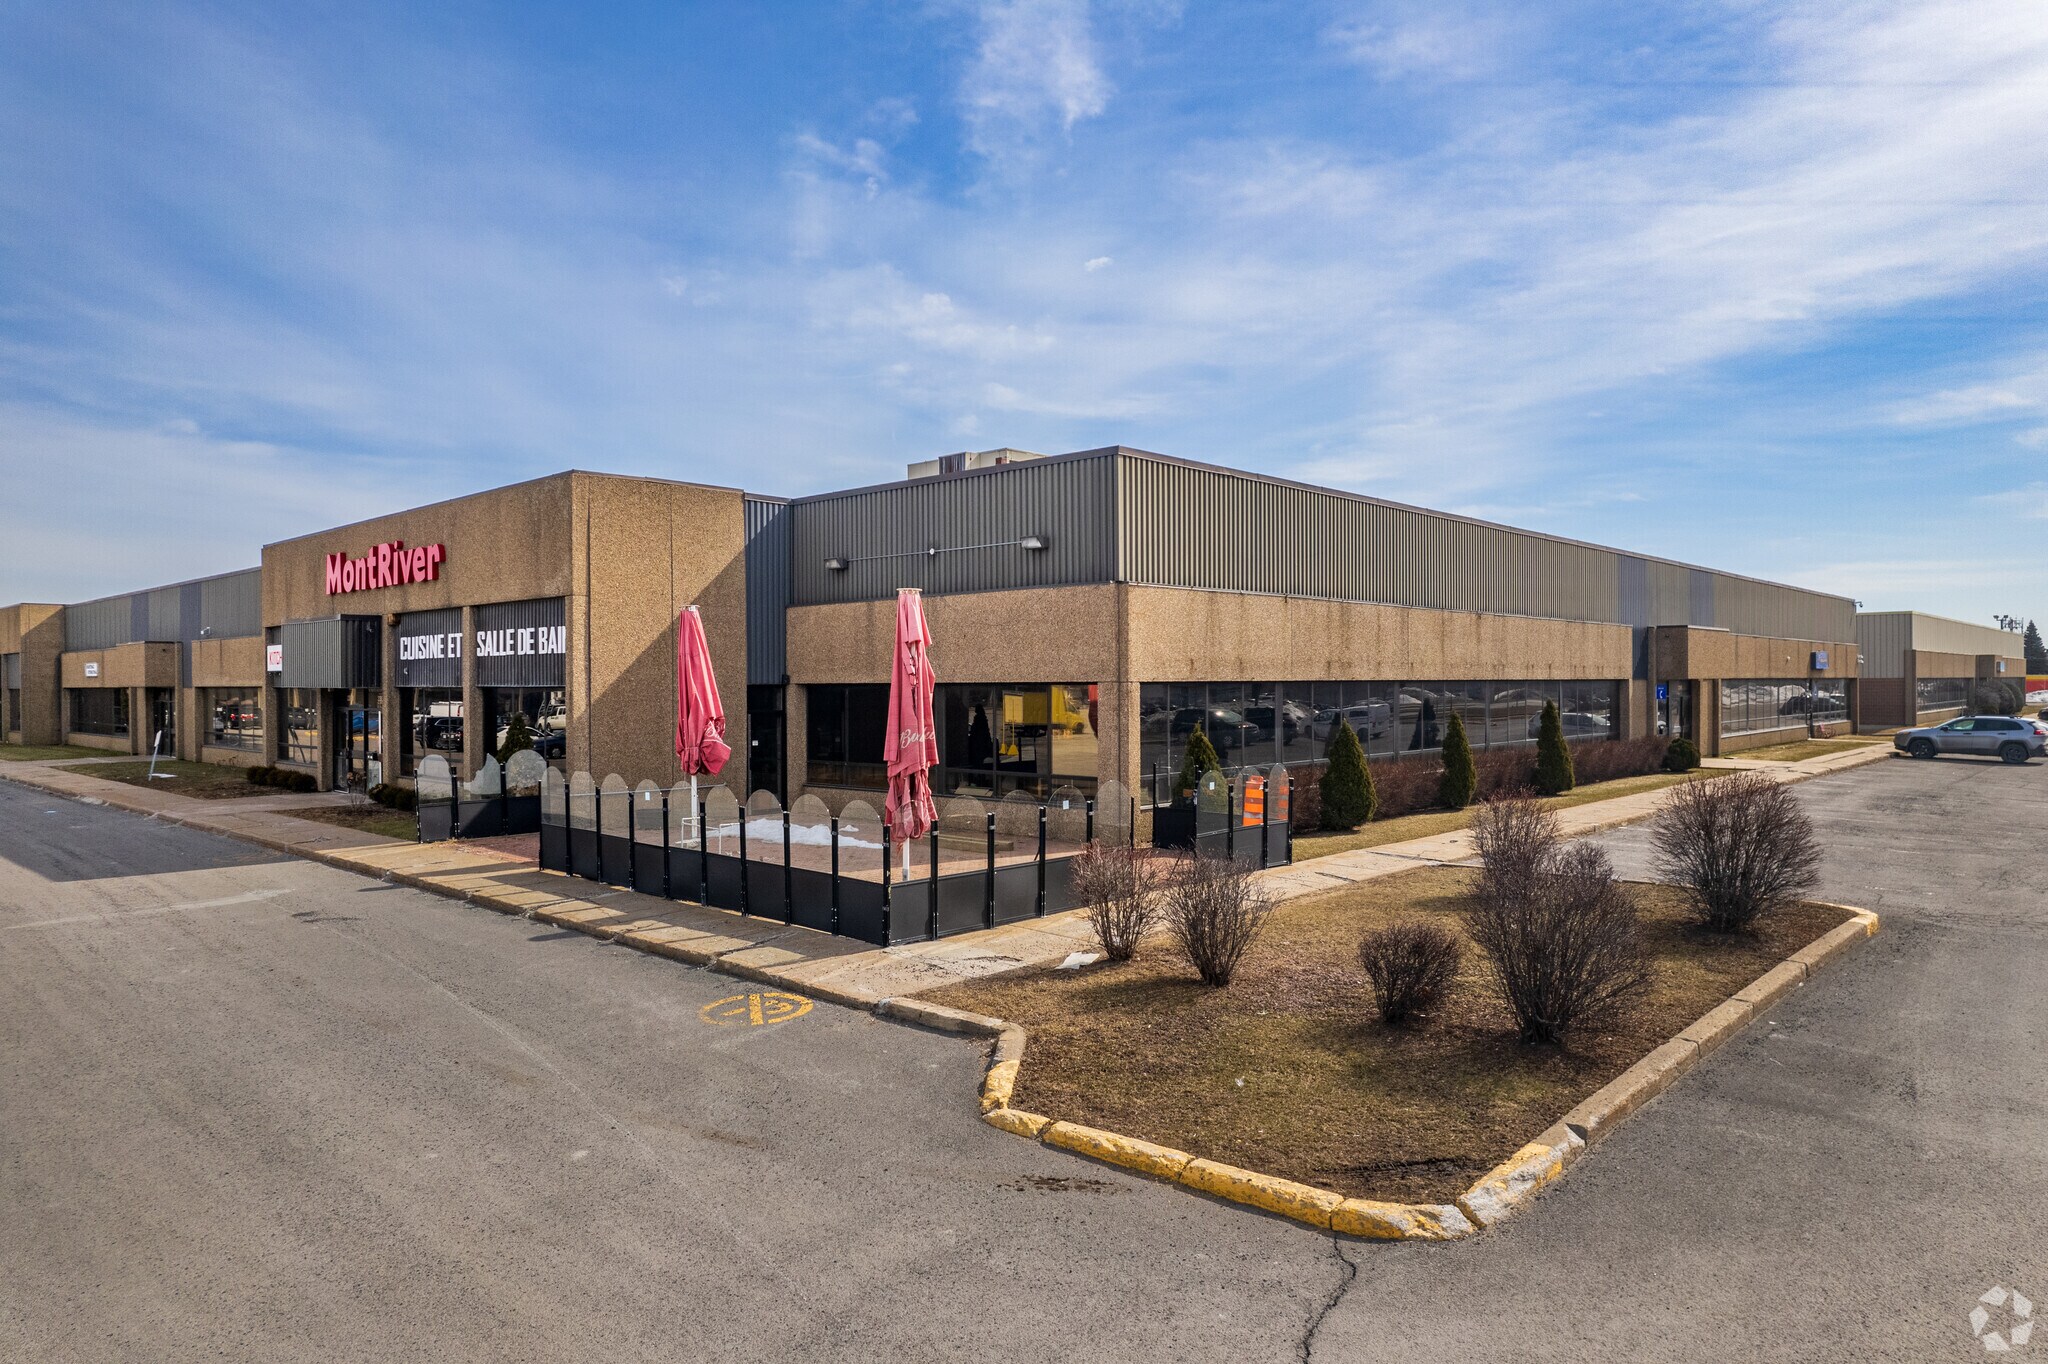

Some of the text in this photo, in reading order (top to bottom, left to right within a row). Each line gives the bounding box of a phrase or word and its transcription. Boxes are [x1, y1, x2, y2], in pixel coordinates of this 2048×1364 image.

[325, 540, 446, 595] MontRiver
[400, 633, 463, 660] CUISINE ET
[476, 629, 515, 657] SALLE
[517, 627, 535, 655] DE
